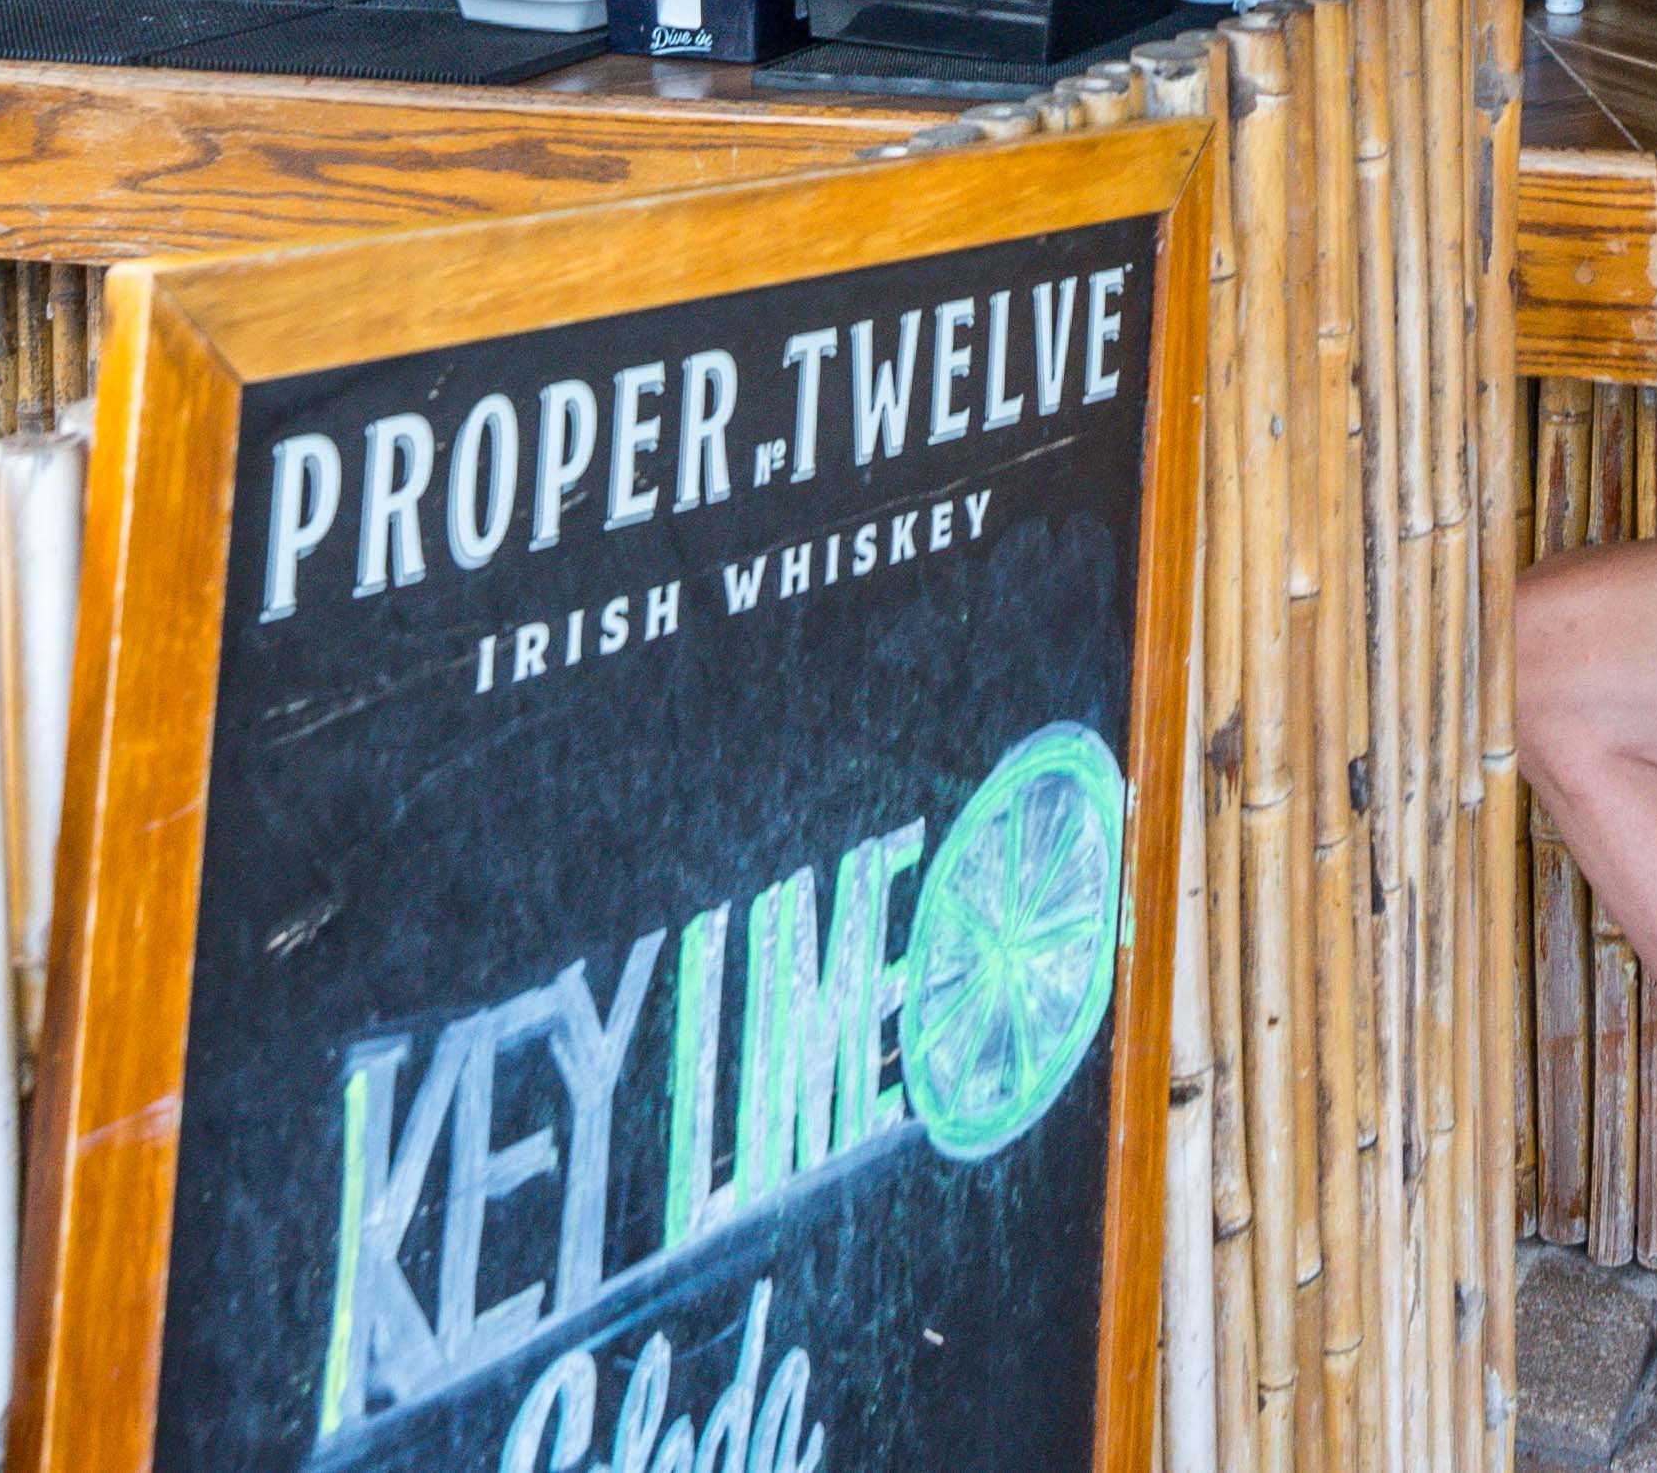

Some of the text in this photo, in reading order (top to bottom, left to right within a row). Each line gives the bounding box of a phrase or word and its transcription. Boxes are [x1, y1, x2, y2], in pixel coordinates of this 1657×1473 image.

[650, 26, 714, 53] Dive in
[257, 265, 1128, 627] PROPER TWELVE
[473, 487, 996, 696] IRISH WHISKEY
[318, 926, 669, 1440] KEY
[661, 815, 927, 1254] LIME
